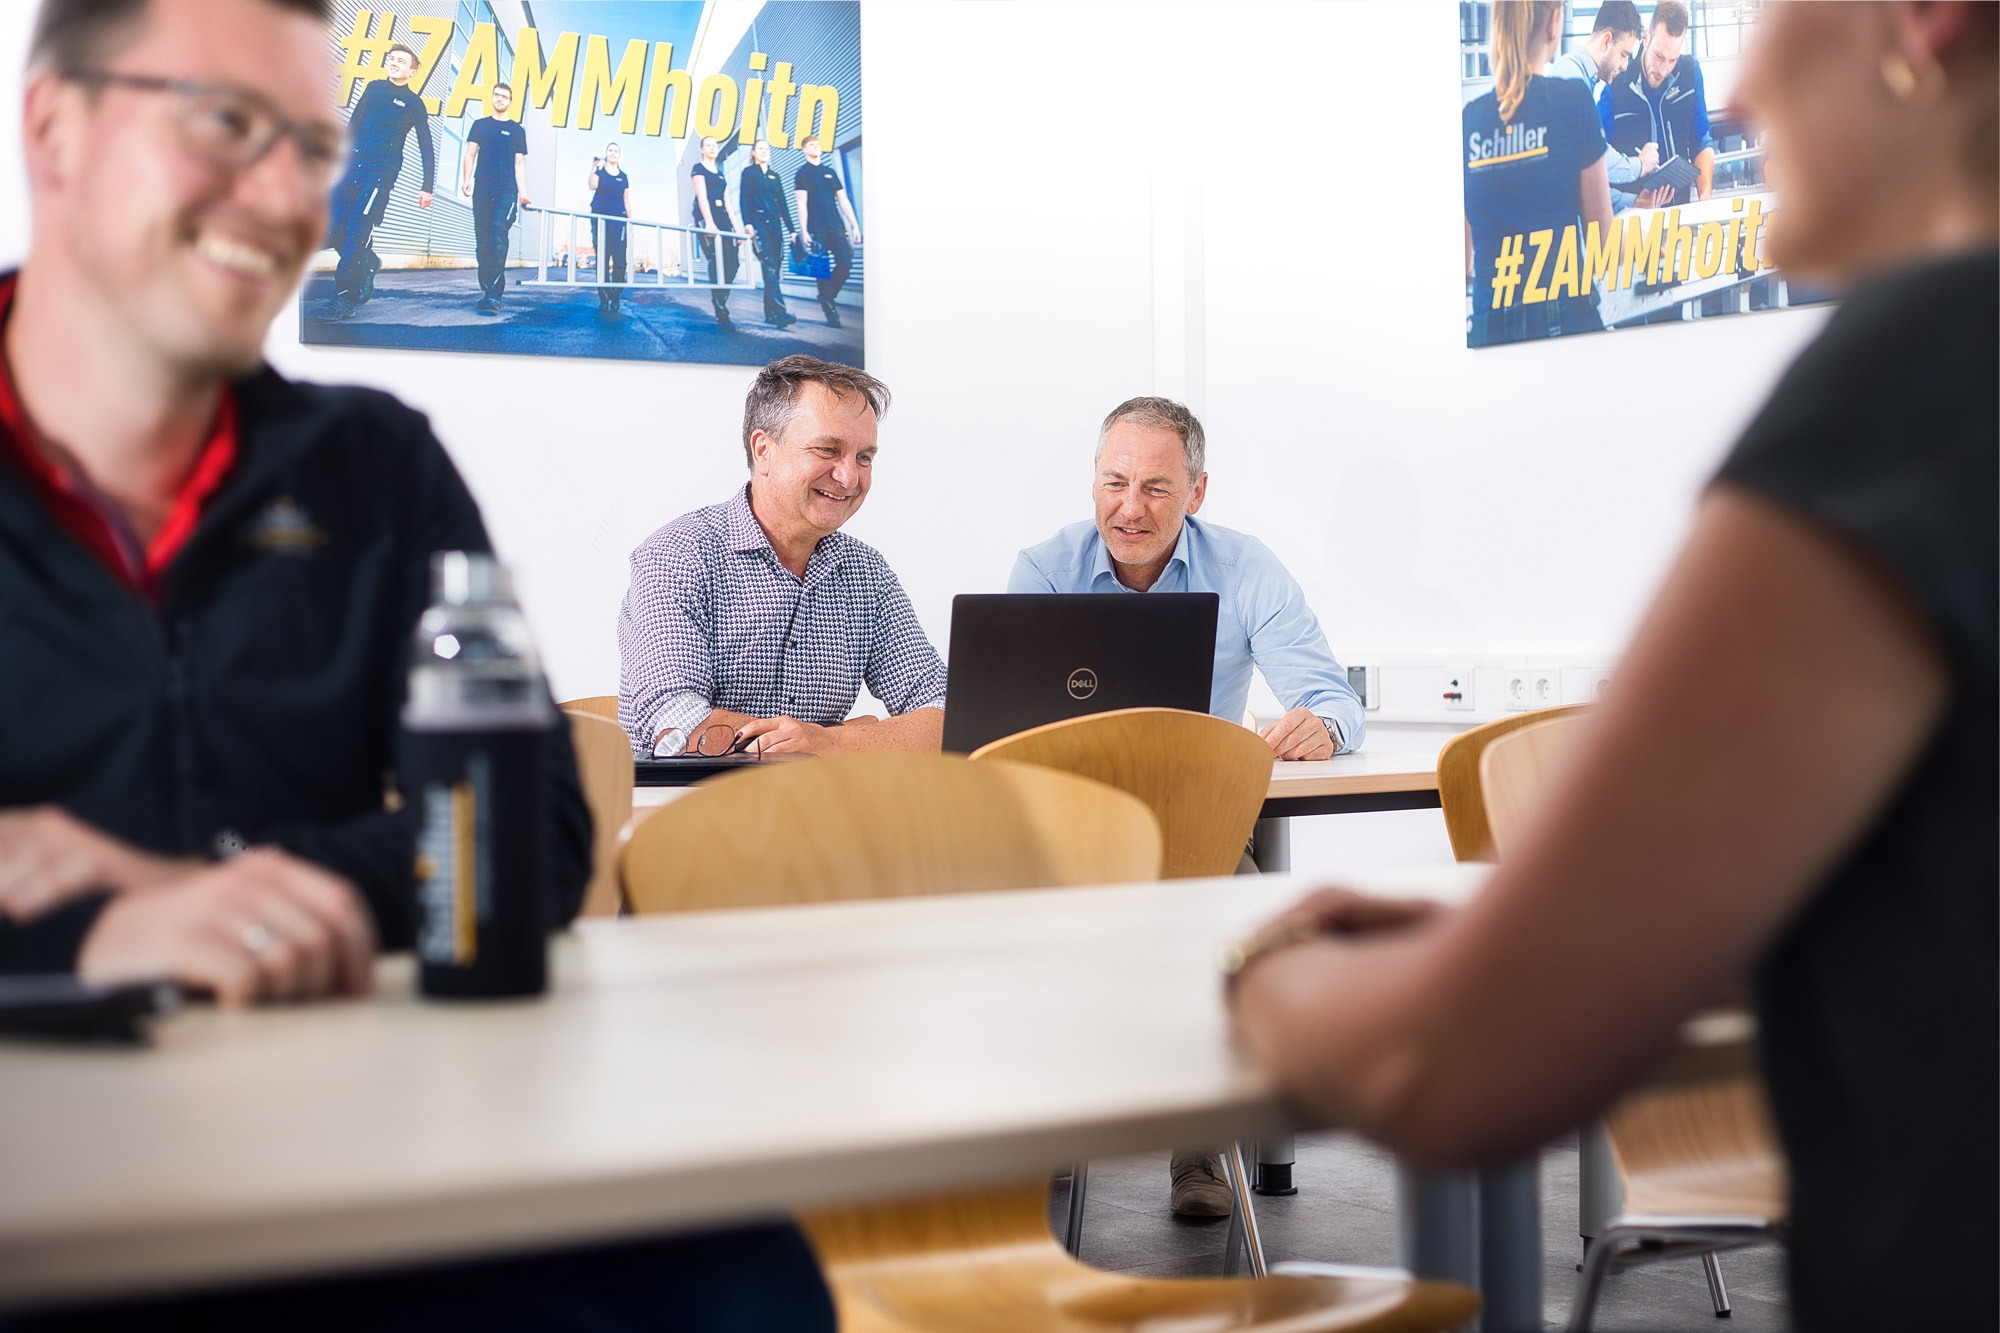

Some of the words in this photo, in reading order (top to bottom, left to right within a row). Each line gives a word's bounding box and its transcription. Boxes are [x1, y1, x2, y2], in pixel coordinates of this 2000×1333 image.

[334, 9, 840, 153] #ZAMMhoitn
[1469, 122, 1547, 162] Schiller
[1071, 679, 1094, 688] DELL
